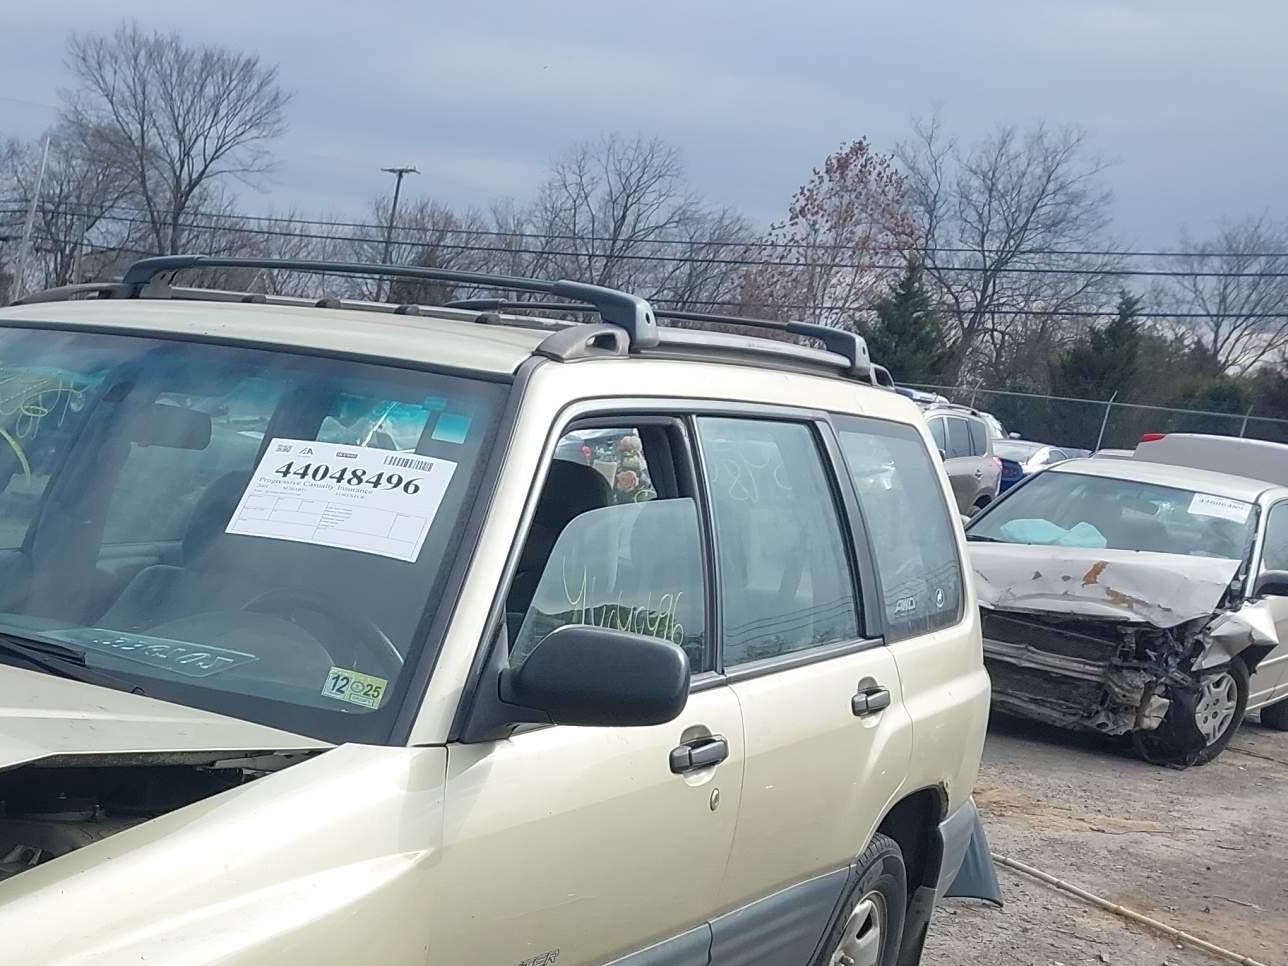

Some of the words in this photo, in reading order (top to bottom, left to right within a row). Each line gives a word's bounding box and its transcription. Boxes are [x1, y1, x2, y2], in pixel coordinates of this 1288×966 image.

[275, 460, 424, 496] 44048496
[330, 673, 350, 694] 12
[363, 683, 382, 699] 25
